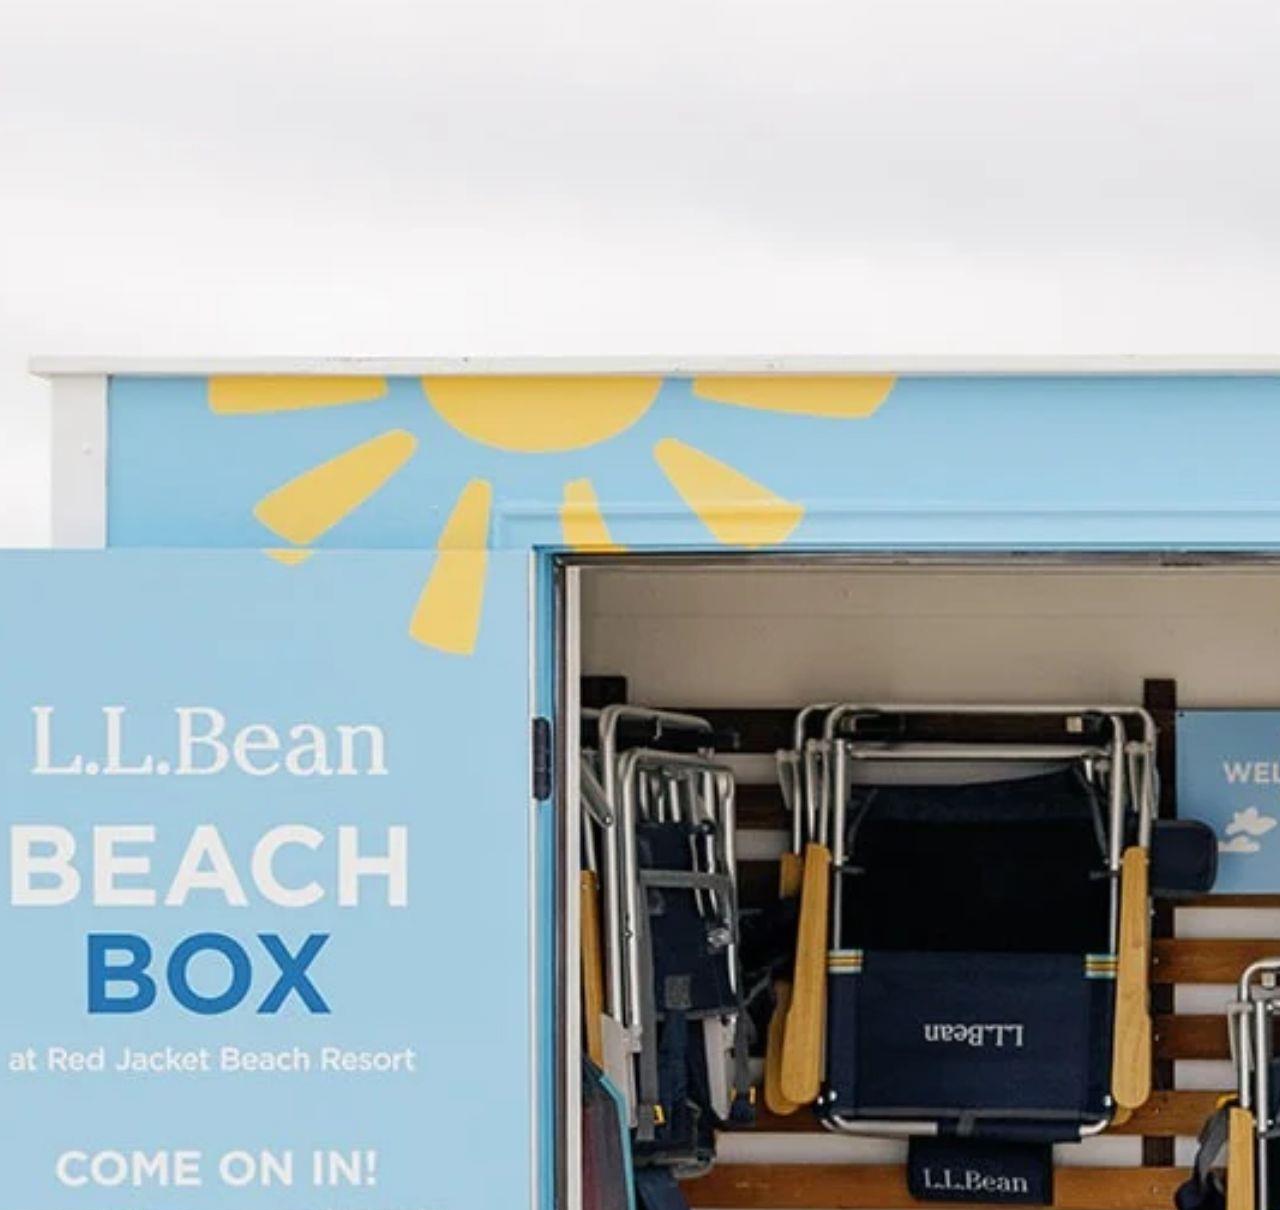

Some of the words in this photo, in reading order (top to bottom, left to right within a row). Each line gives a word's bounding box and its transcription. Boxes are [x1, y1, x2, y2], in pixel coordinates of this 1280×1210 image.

[32, 706, 388, 776] L.L.Bean
[11, 825, 407, 907] BEACH
[87, 933, 331, 1015] BOX
[925, 1024, 1023, 1046] L.L.Bean
[9, 1048, 37, 1072] at
[49, 1047, 105, 1071] Red
[116, 1046, 210, 1072] Jacket
[221, 1047, 310, 1071] Beach
[321, 1047, 416, 1071] Resort
[56, 1151, 202, 1186] COME
[219, 1150, 292, 1186] ON
[314, 1150, 375, 1185] IN!
[924, 1168, 1027, 1192] L.L.Bean
